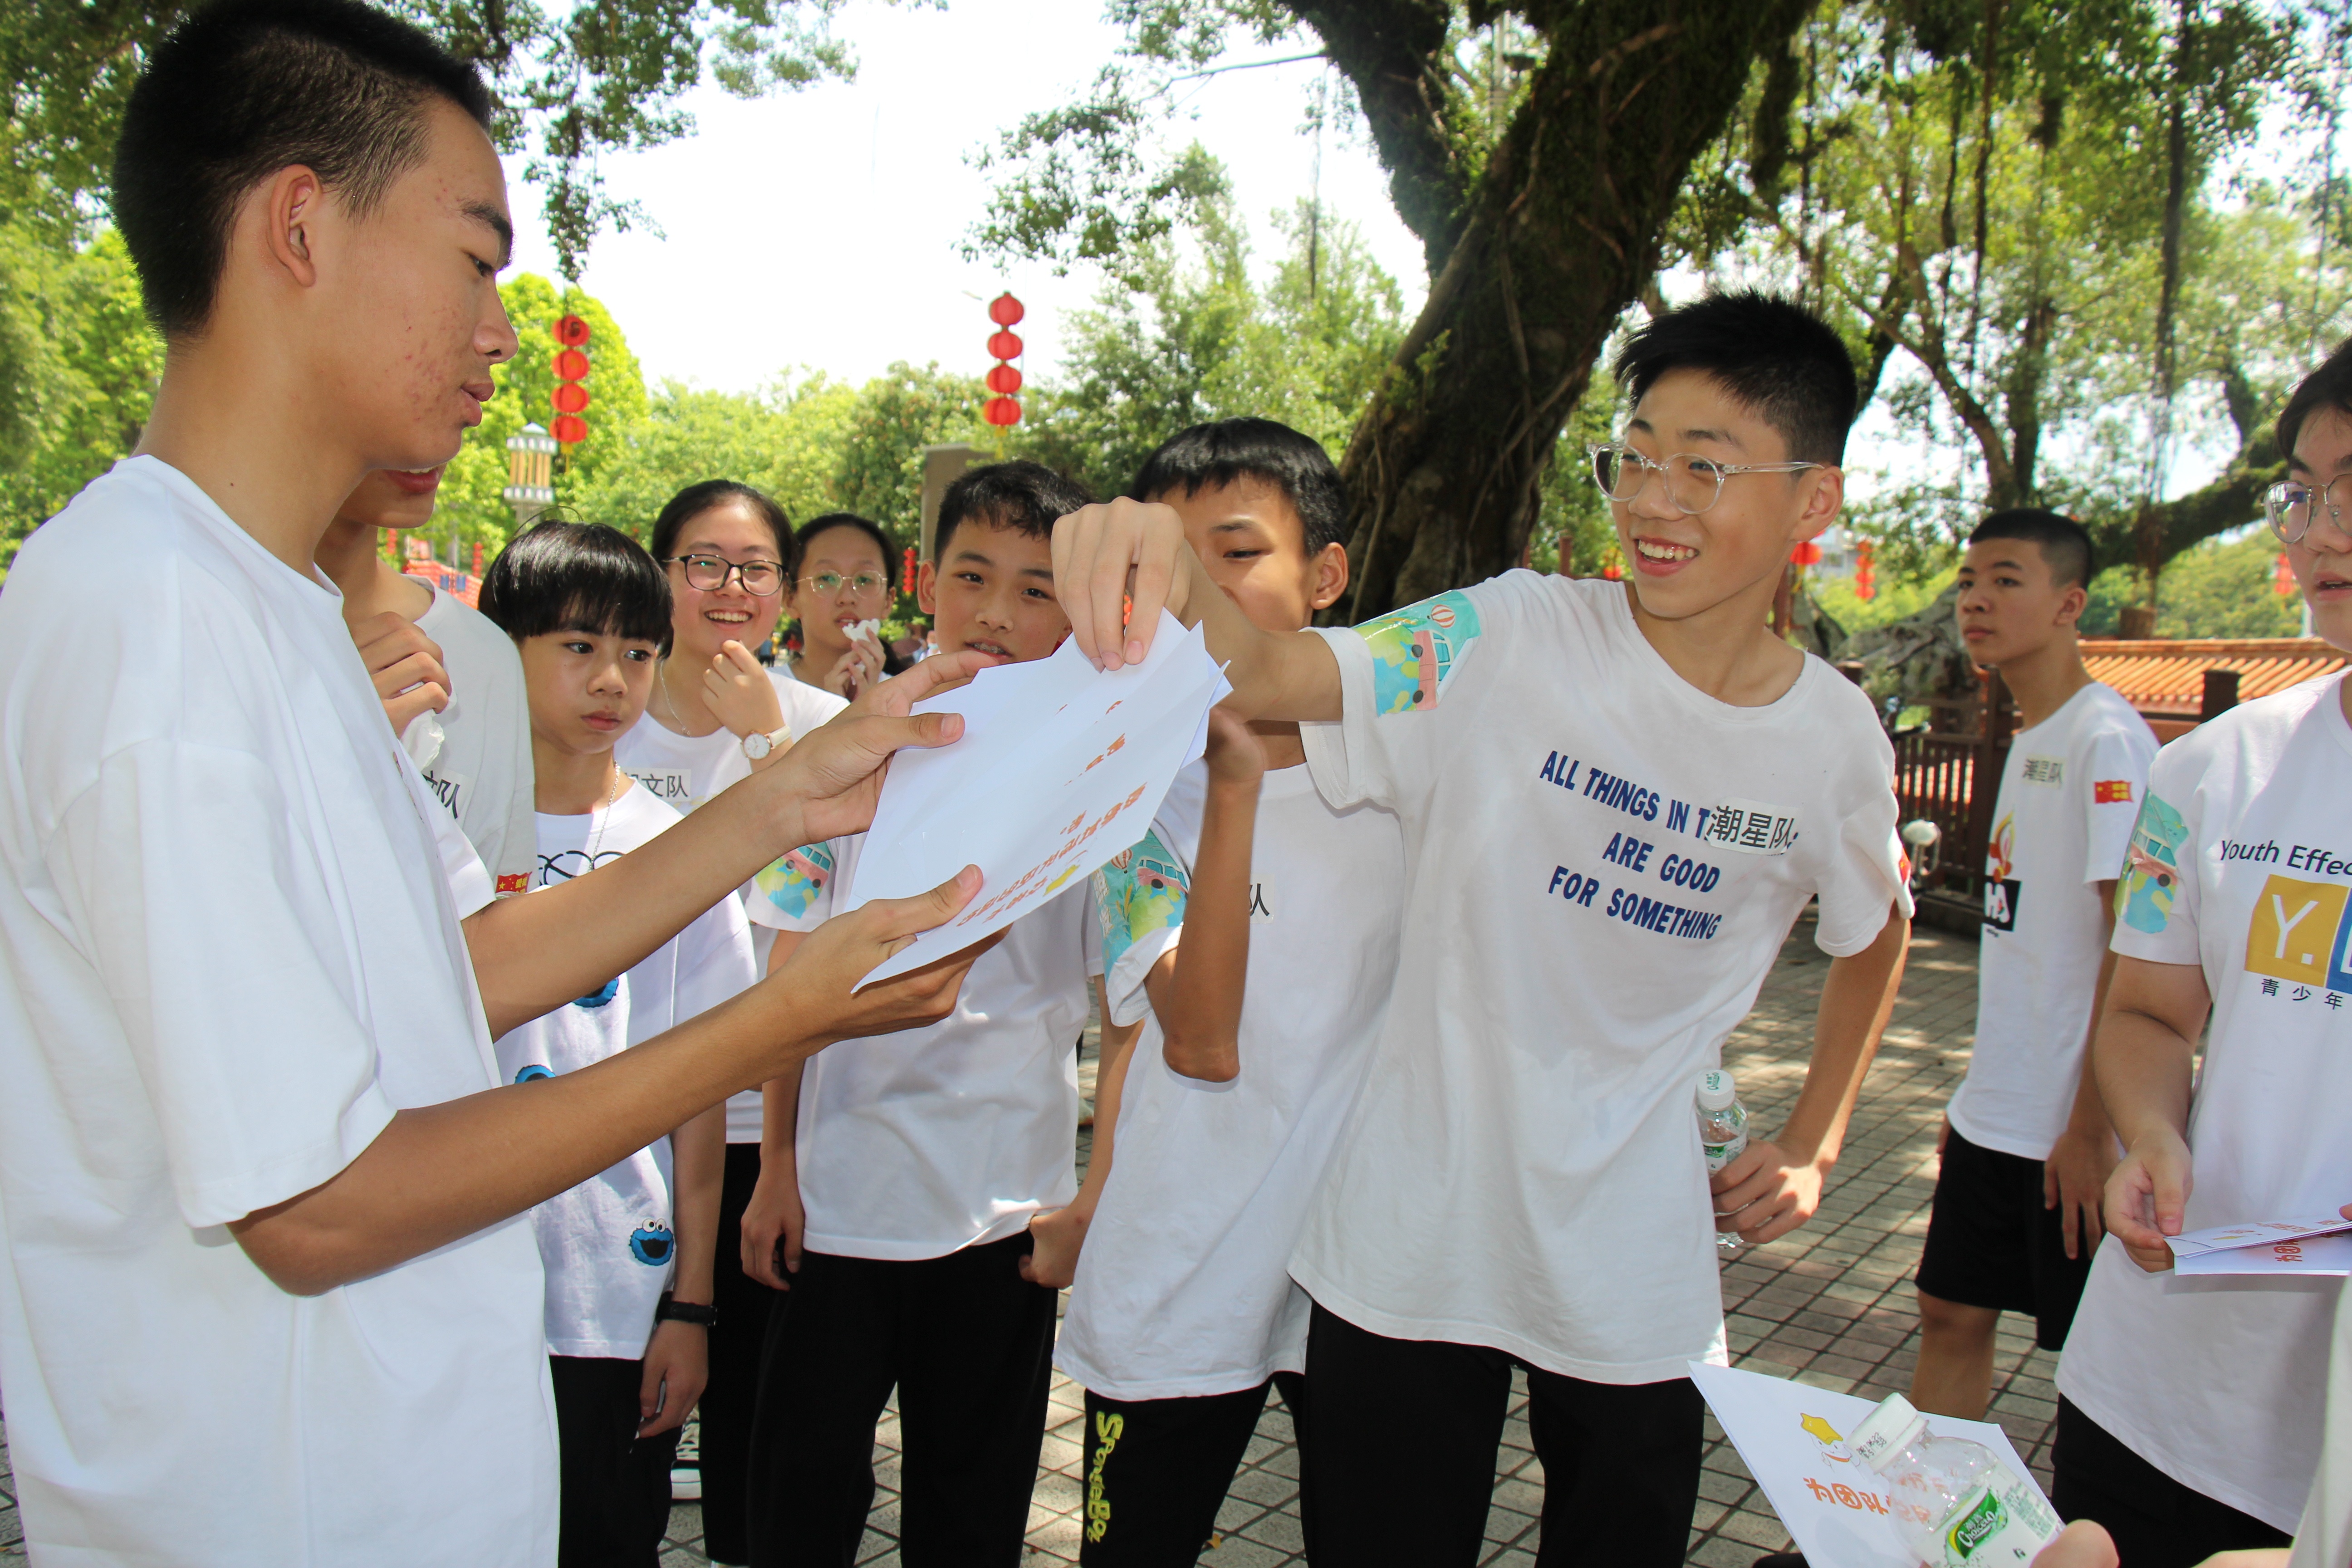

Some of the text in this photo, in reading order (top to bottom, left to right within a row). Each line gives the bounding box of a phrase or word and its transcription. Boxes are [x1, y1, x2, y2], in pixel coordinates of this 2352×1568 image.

[625, 773, 688, 798] 文队
[1539, 750, 1579, 790] ALL
[1583, 767, 1660, 821] THINGS
[1666, 799, 1690, 833] IN
[1706, 805, 1795, 849] 潮星队
[1602, 832, 1720, 892] ARE GOOD
[2220, 839, 2280, 862] Youth
[1548, 865, 1722, 940] FOR SOMETHING
[2261, 978, 2343, 1010] 青少年
